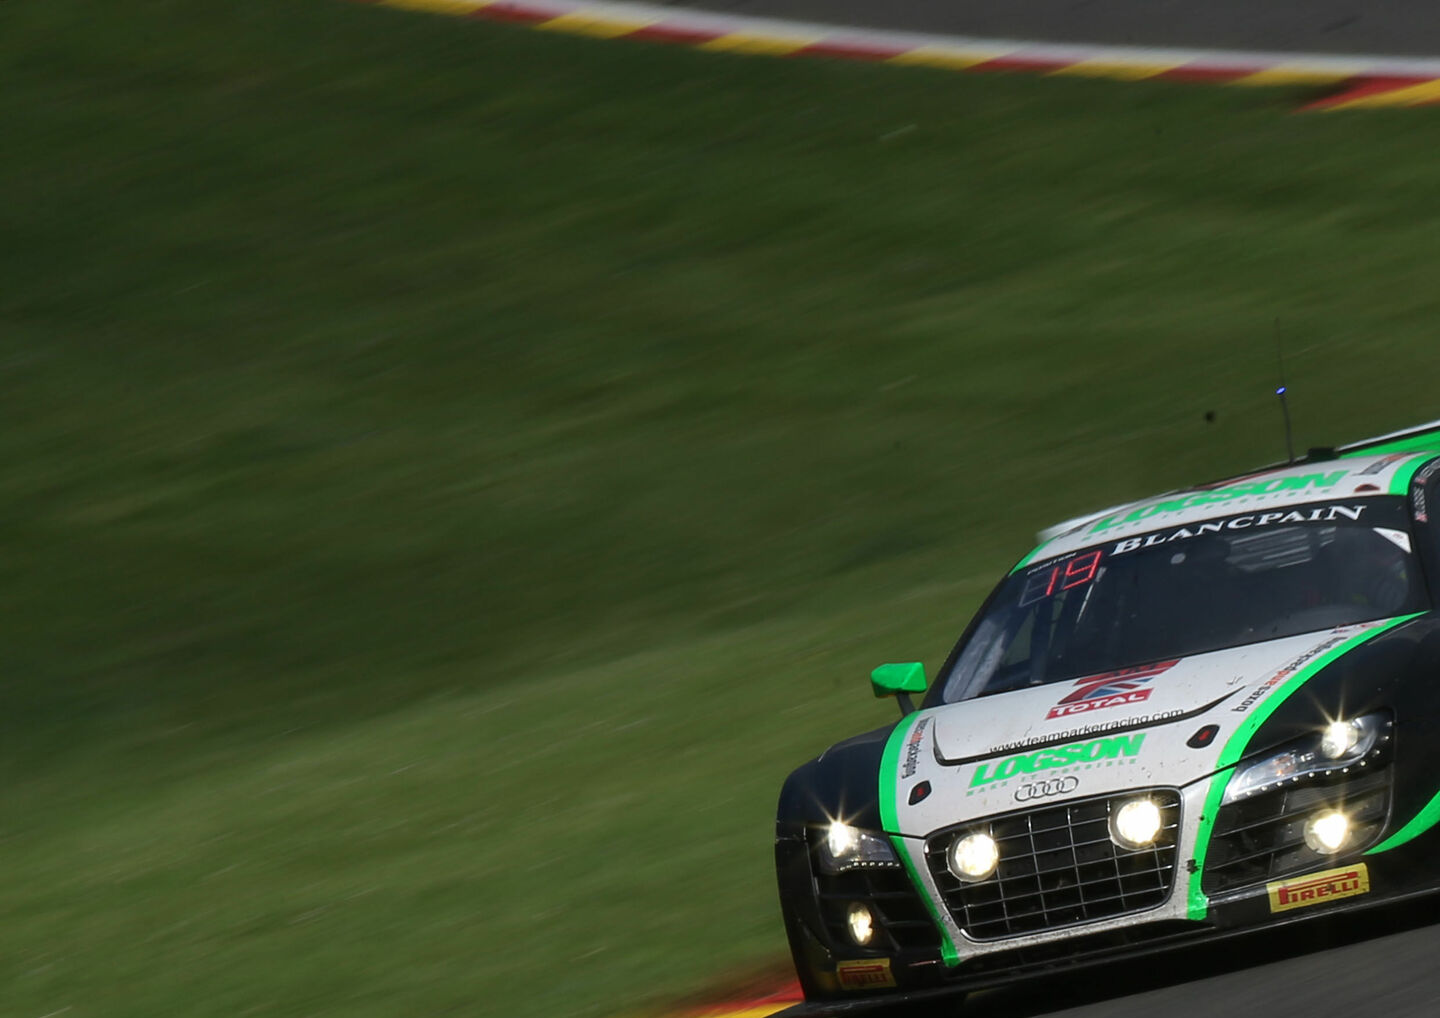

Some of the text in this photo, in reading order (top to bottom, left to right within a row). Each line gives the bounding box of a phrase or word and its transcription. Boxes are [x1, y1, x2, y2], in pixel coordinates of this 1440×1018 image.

[1109, 504, 1367, 557] BLANCPAIN
[1053, 692, 1147, 716] TOTAL
[968, 732, 1148, 790] LOGSON
[1278, 871, 1359, 906] PIRELLI
